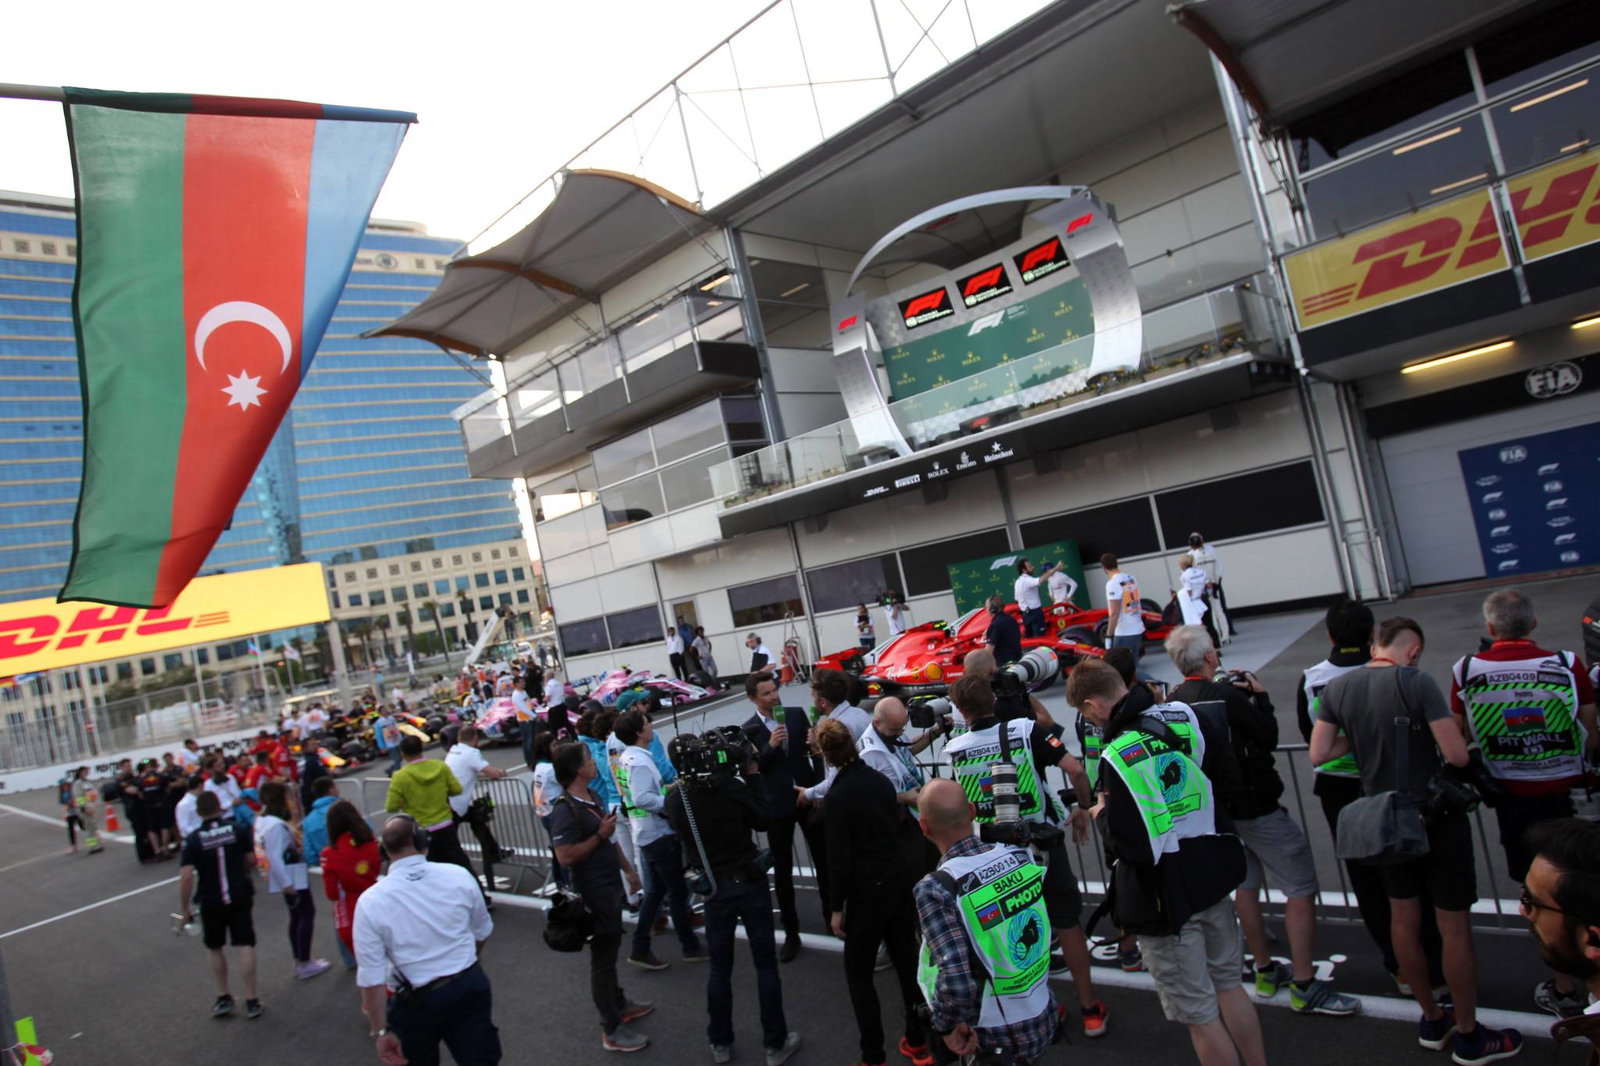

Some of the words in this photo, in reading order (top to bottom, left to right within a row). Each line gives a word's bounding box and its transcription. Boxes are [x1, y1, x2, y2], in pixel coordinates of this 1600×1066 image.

[1022, 239, 1060, 272] F1
[963, 266, 1003, 296] F1
[904, 289, 946, 318] F1
[967, 310, 1005, 336] F1
[1528, 367, 1578, 394] FIA
[984, 449, 1014, 463] Heineken
[1500, 447, 1525, 461] FIA
[928, 468, 950, 479] ROLEX
[956, 460, 977, 471] Emirates
[895, 474, 921, 488] PIRELLI
[0, 606, 193, 659] DHL
[1498, 735, 1520, 746] PIT
[978, 801, 993, 811] PIT
[993, 872, 1024, 894] BAKU
[1005, 880, 1043, 913] PHOTO
